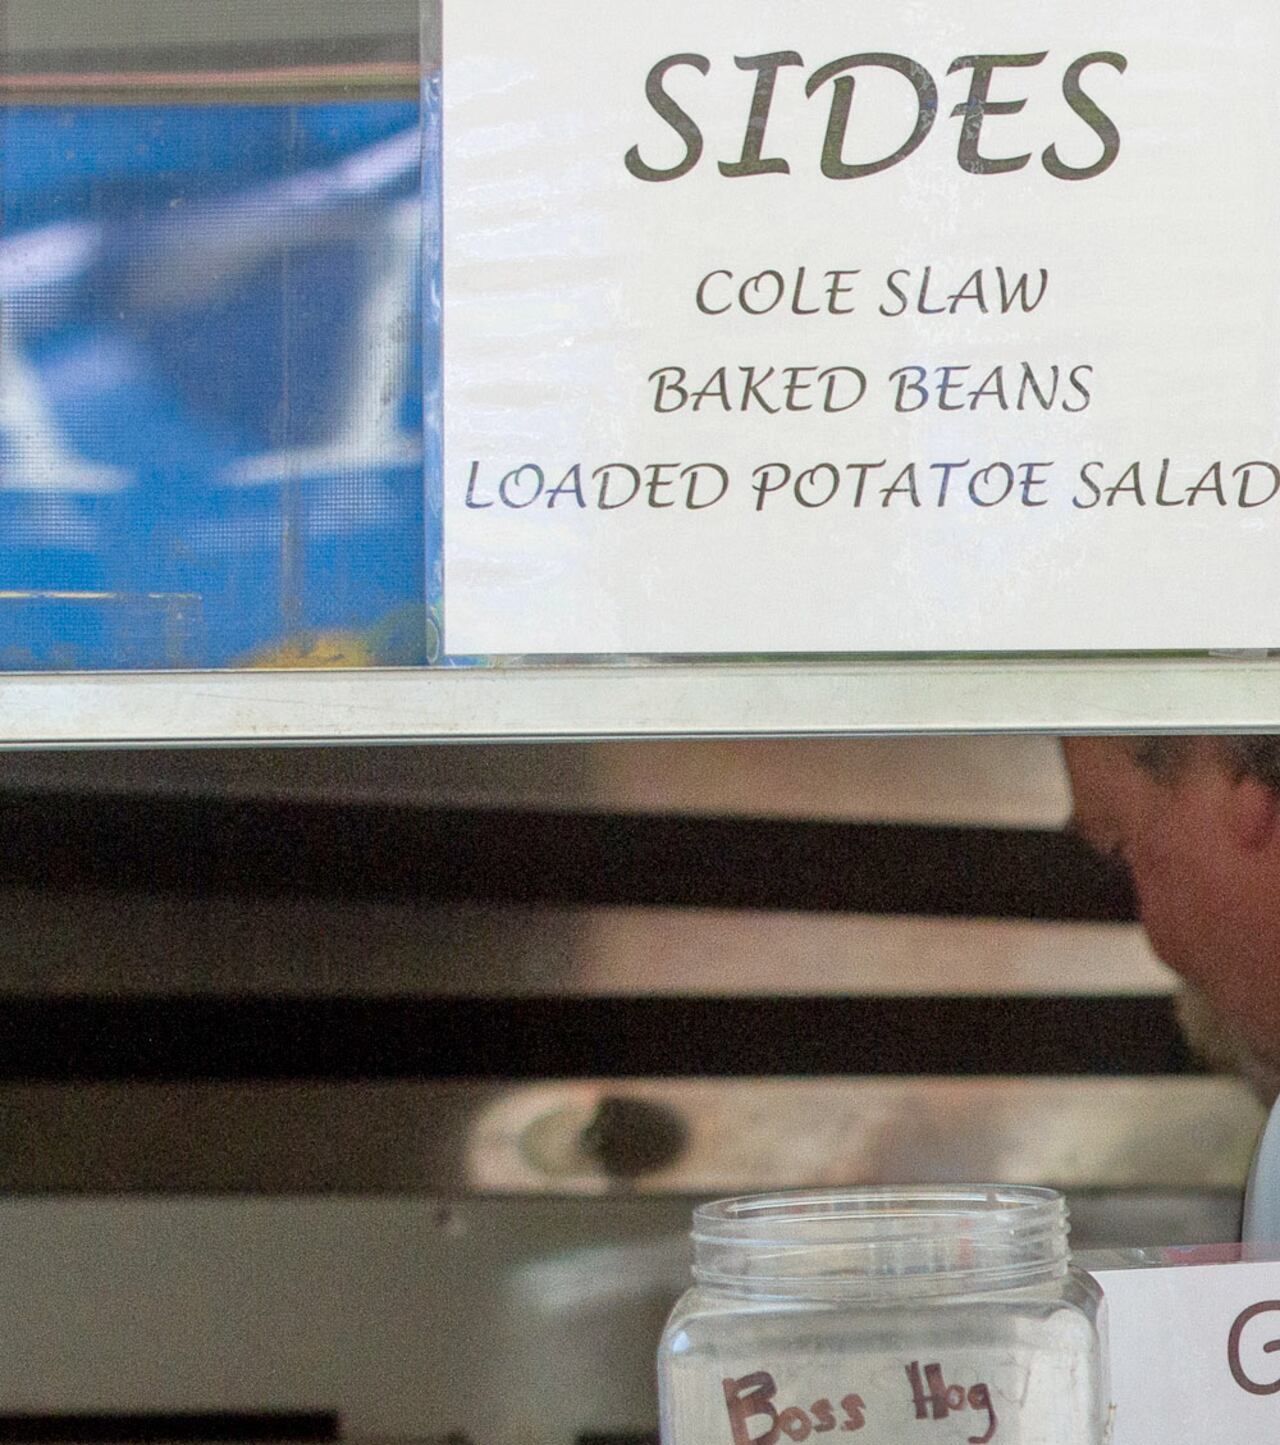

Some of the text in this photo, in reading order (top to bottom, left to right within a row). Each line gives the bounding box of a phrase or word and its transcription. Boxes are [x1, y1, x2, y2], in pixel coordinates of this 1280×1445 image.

[623, 49, 1129, 184] SIDES
[694, 264, 1049, 318] COLE SLAW
[647, 360, 1094, 416] BAKED BEANS
[464, 459, 730, 511] LOADED
[750, 457, 1055, 513] POTATOE
[904, 1360, 998, 1445] Hog
